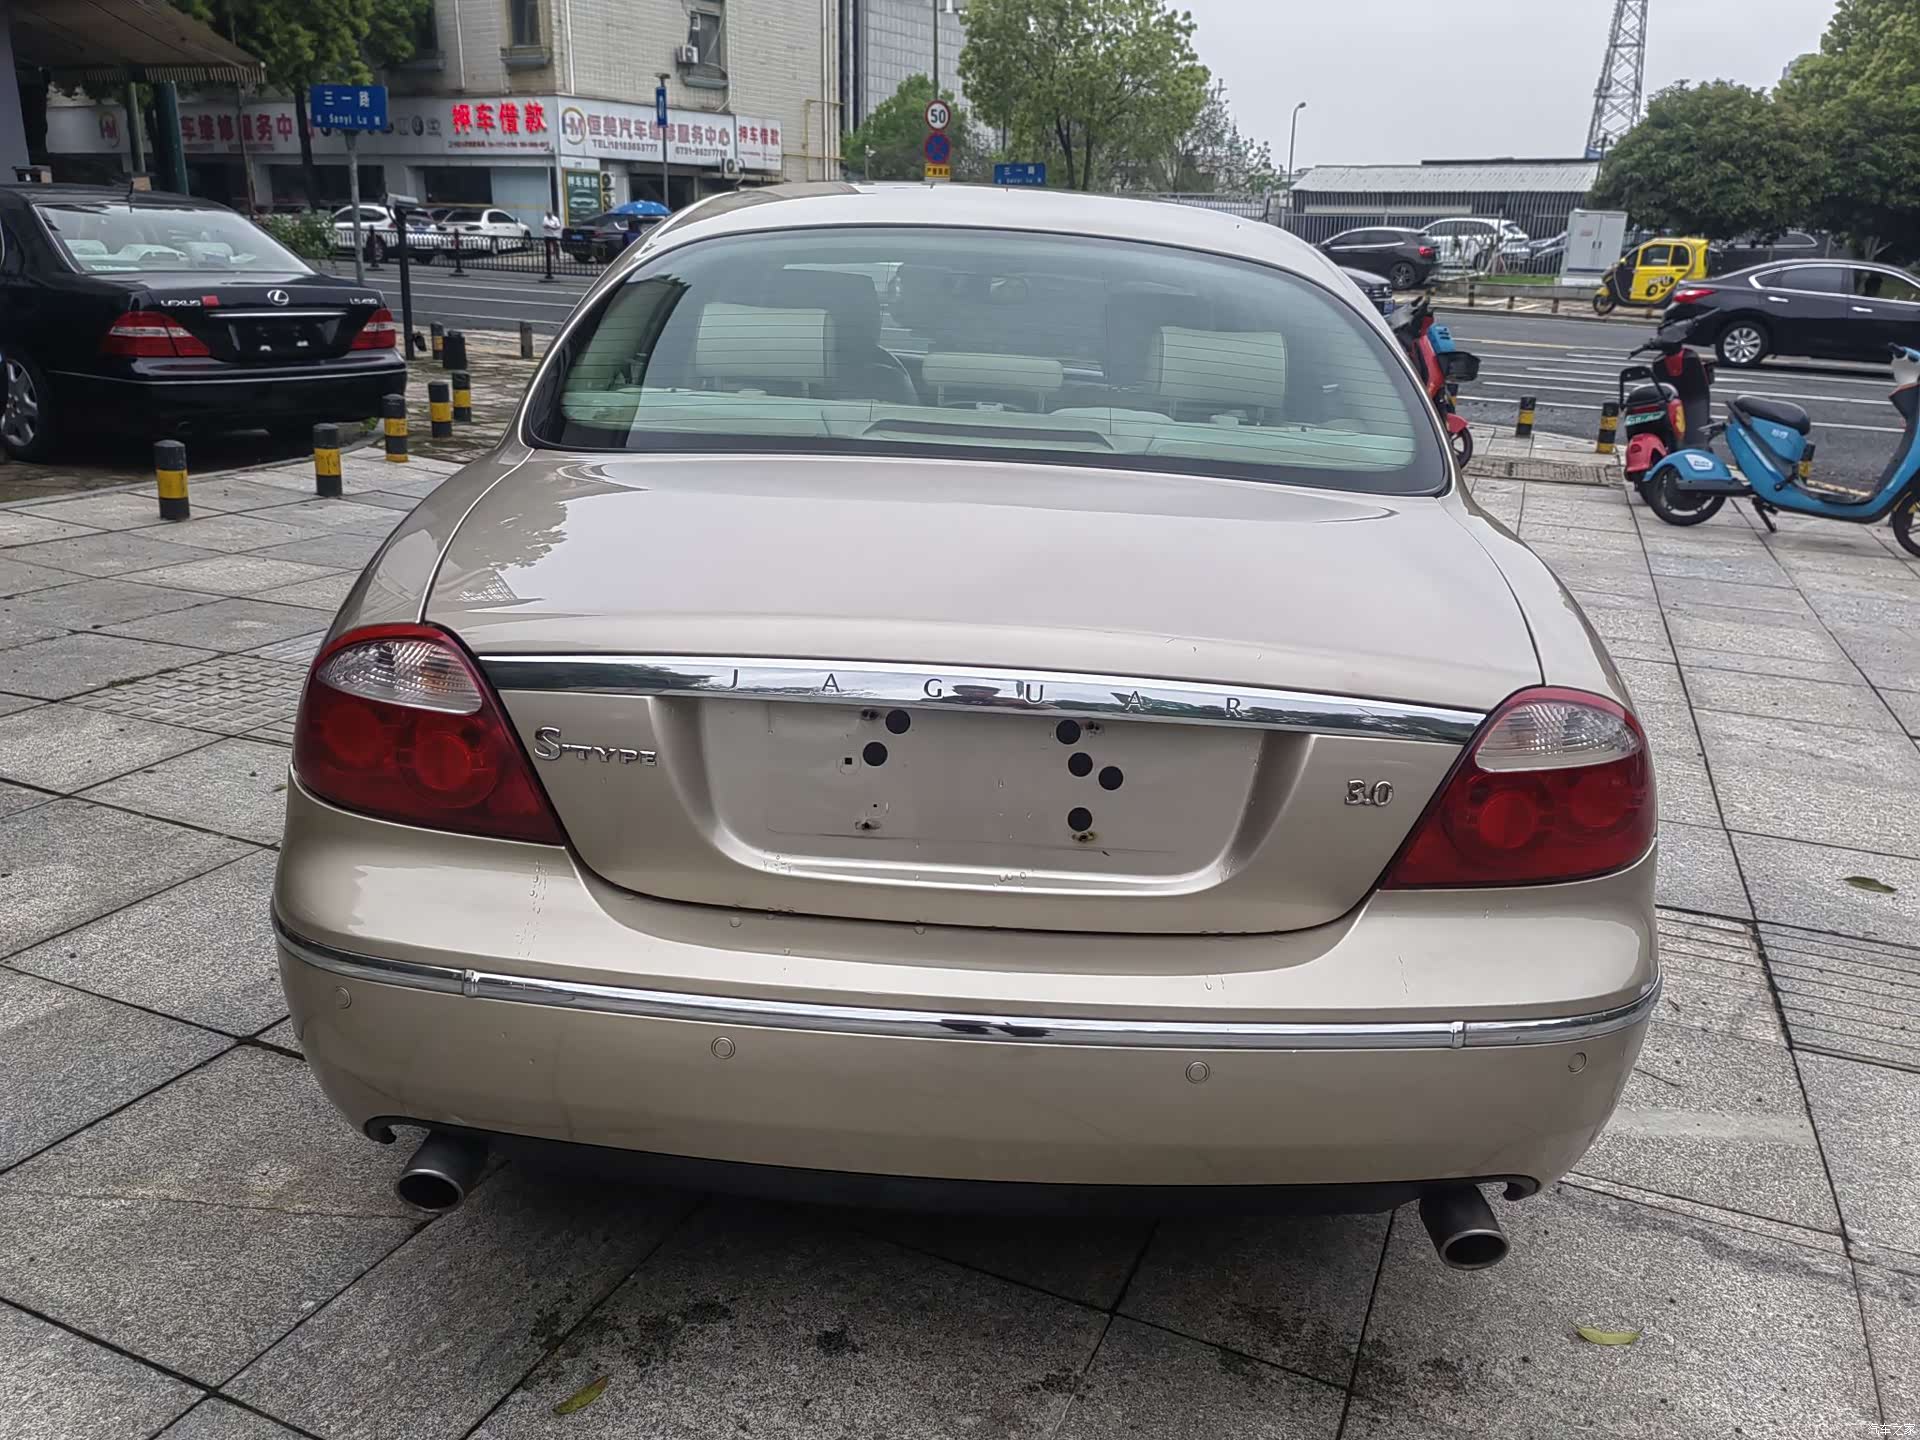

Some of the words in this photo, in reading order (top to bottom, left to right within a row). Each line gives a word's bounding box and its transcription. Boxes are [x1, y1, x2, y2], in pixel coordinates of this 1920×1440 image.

[323, 91, 370, 107] 三一路
[328, 113, 352, 126] Sanyi
[357, 114, 368, 125] Lu
[452, 100, 547, 135] 押车借款
[930, 109, 946, 124] 50
[738, 125, 779, 145] 押车借款
[160, 299, 202, 307] LEXUS
[1345, 779, 1394, 807] 3.0
